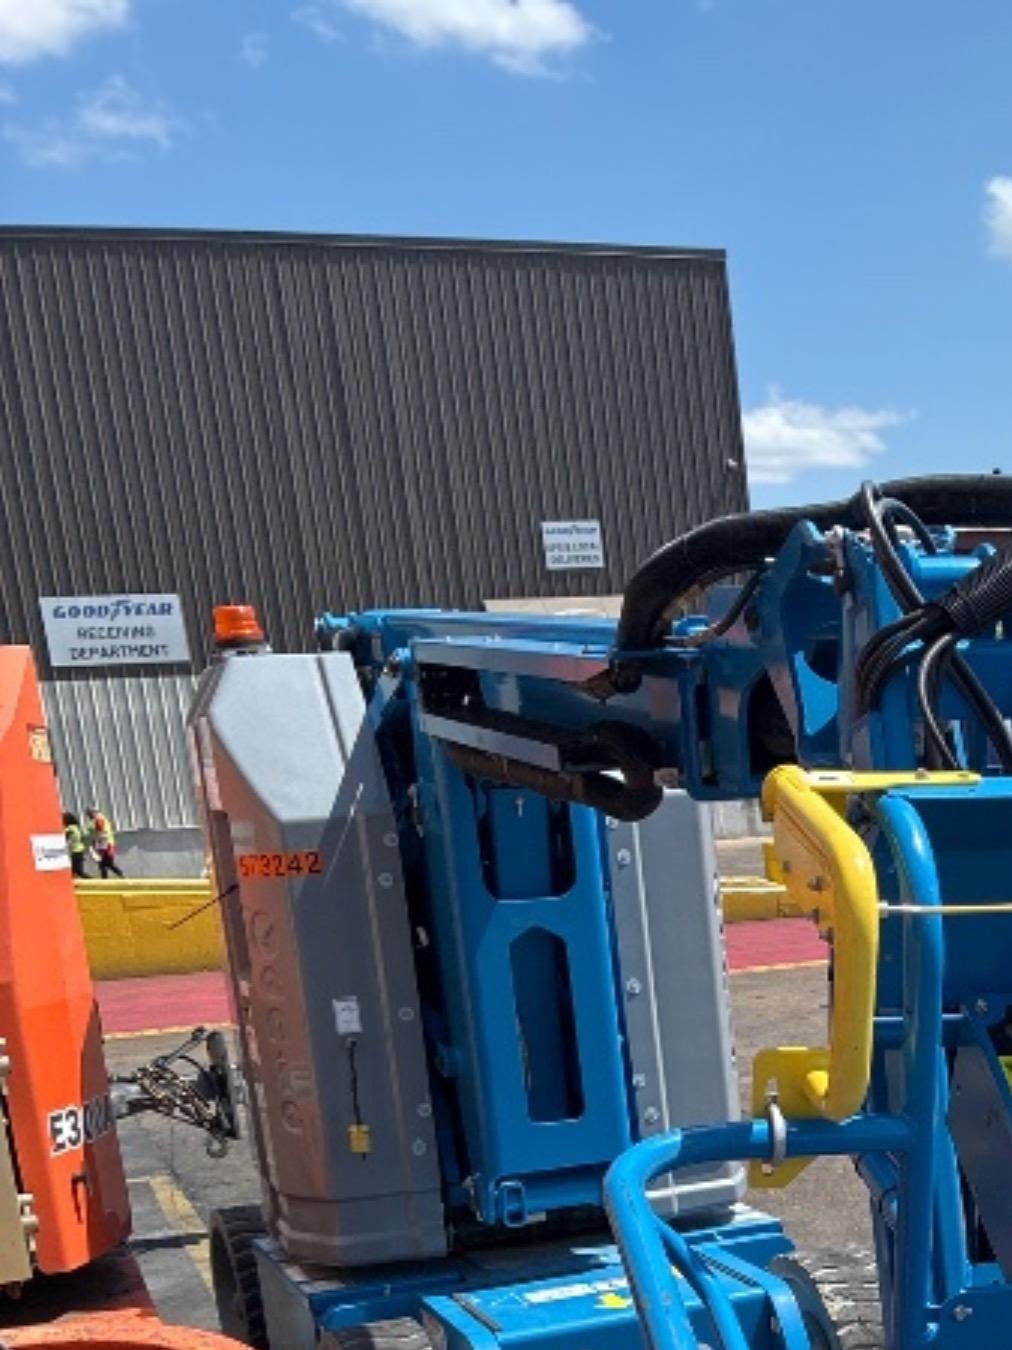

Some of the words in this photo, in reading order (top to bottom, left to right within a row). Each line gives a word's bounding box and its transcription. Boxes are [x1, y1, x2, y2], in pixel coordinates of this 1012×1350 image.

[52, 599, 174, 622] GOODYEAR
[77, 625, 156, 640] RECEIVING
[69, 644, 169, 661] DEPARTMENT
[239, 851, 322, 877] 573242
